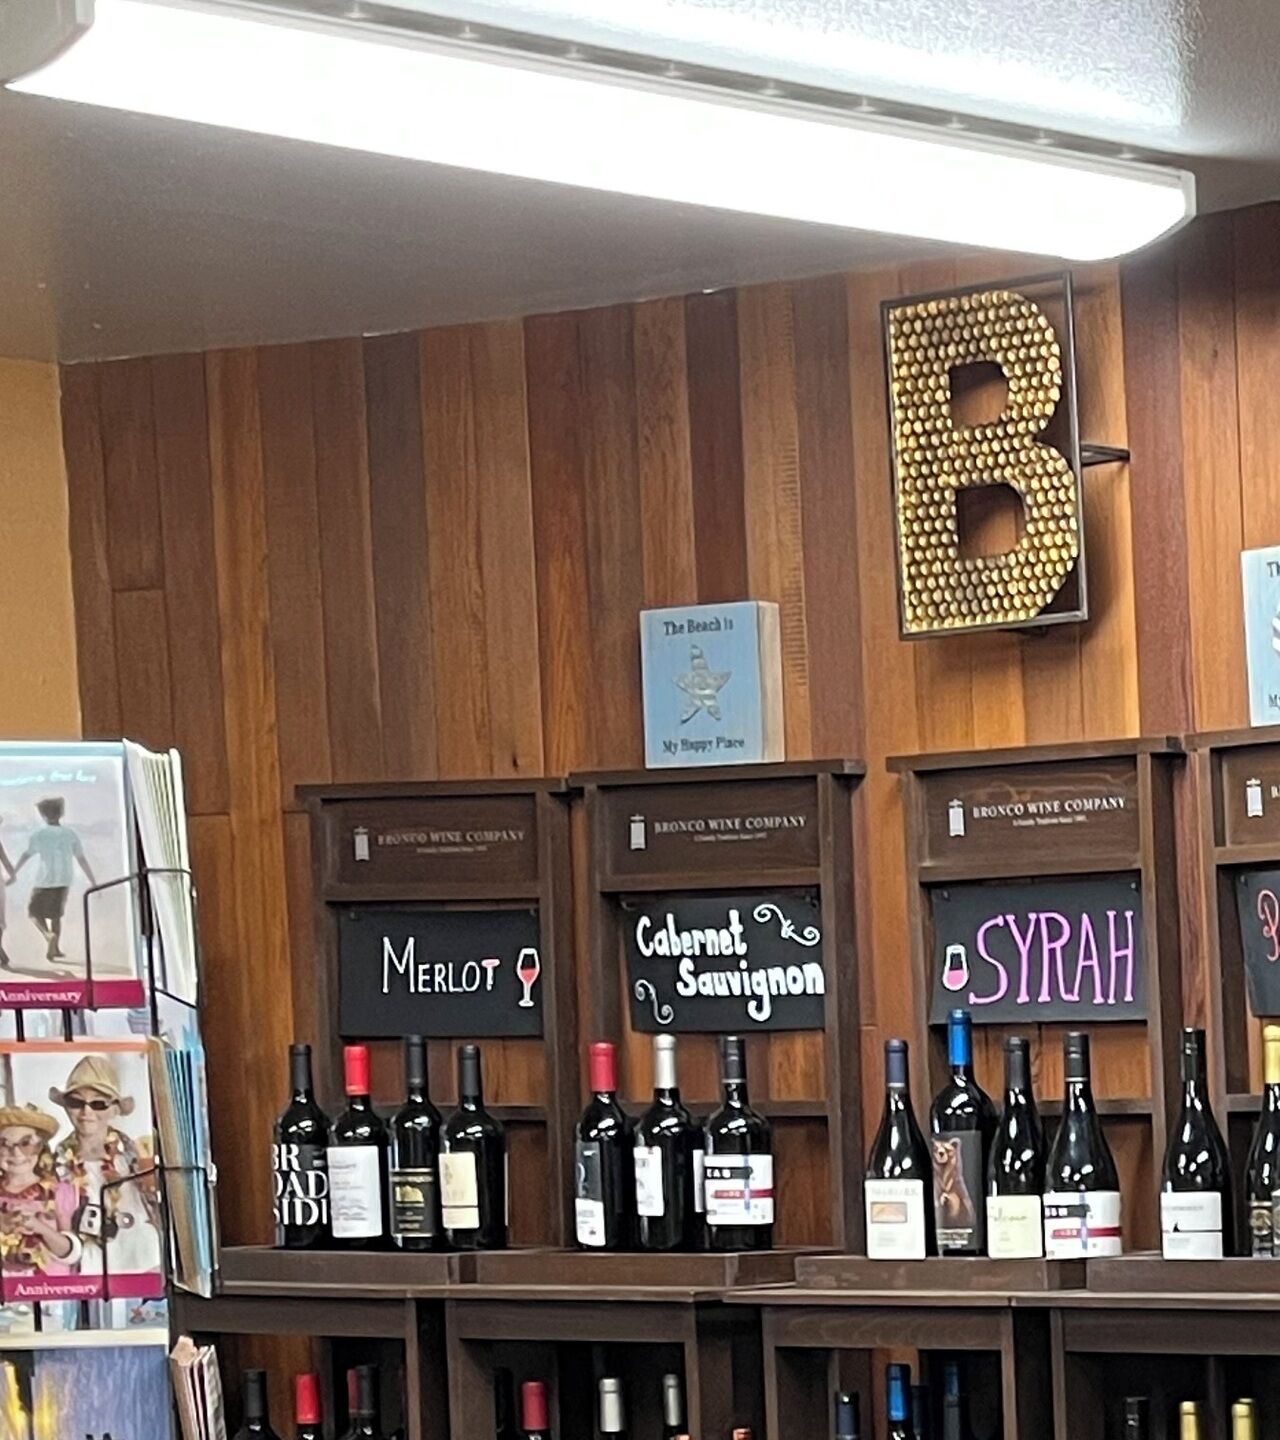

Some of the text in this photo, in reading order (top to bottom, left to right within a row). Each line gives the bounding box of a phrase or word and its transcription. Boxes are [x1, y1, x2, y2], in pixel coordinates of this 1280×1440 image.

[887, 289, 1080, 633] B
[654, 816, 807, 835] BRONCO WINE COMPANY
[972, 796, 1126, 819] BRONCO WINE COMPANY
[636, 908, 748, 960] Cabernet
[969, 910, 1135, 1006] SYRAH
[381, 934, 501, 995] MERLOT
[676, 959, 826, 1022] Sauvignon
[14, 1281, 100, 1298] Anniversary
